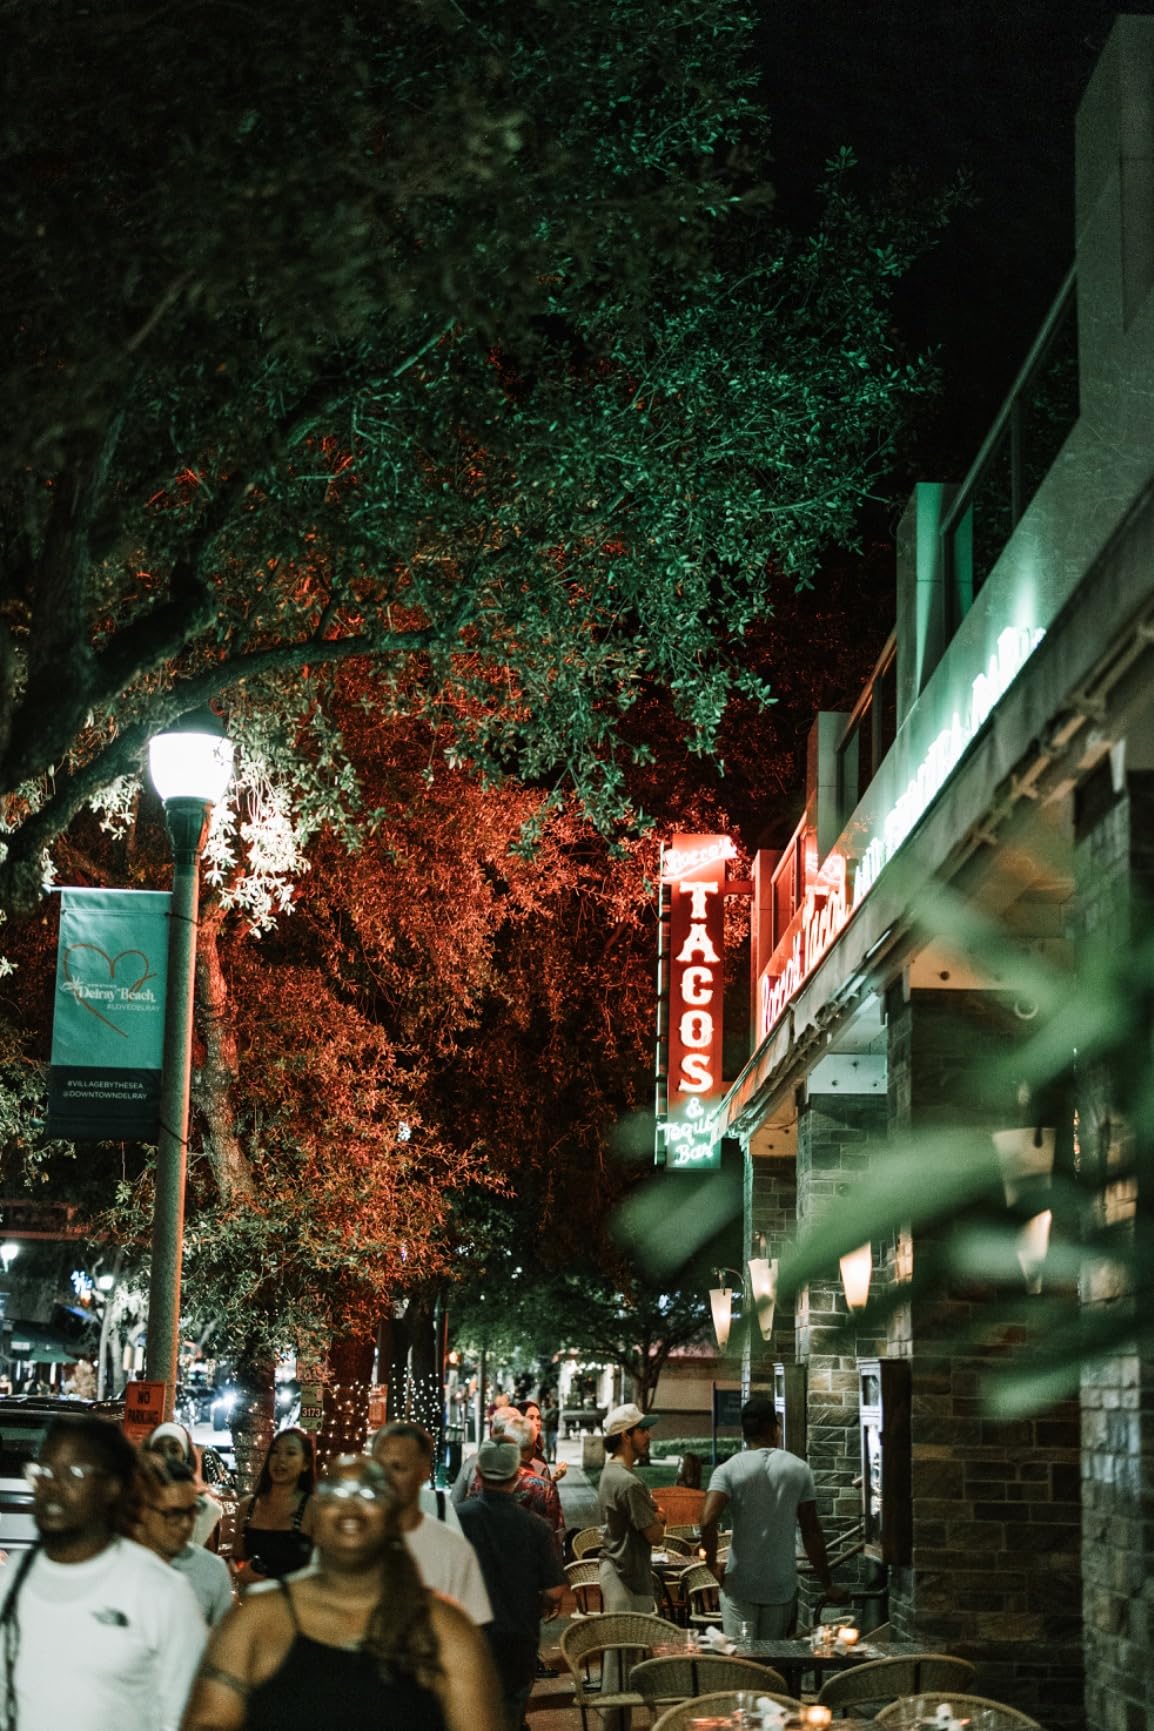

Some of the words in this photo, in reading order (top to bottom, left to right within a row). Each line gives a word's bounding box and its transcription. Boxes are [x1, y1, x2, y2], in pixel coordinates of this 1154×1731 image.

[79, 986, 115, 1002] Delray
[120, 987, 156, 1003] Beach
[675, 881, 720, 1093] TACOS
[67, 1080, 144, 1089] #VILLAGEBYTHESEA
[63, 1090, 148, 1099] @DOWNTOWNDELRAY
[686, 1097, 704, 1119] &
[674, 1144, 713, 1165] Bar
[137, 1391, 151, 1405] NO
[127, 1408, 160, 1425] PARKING
[302, 1407, 321, 1417] 3173
